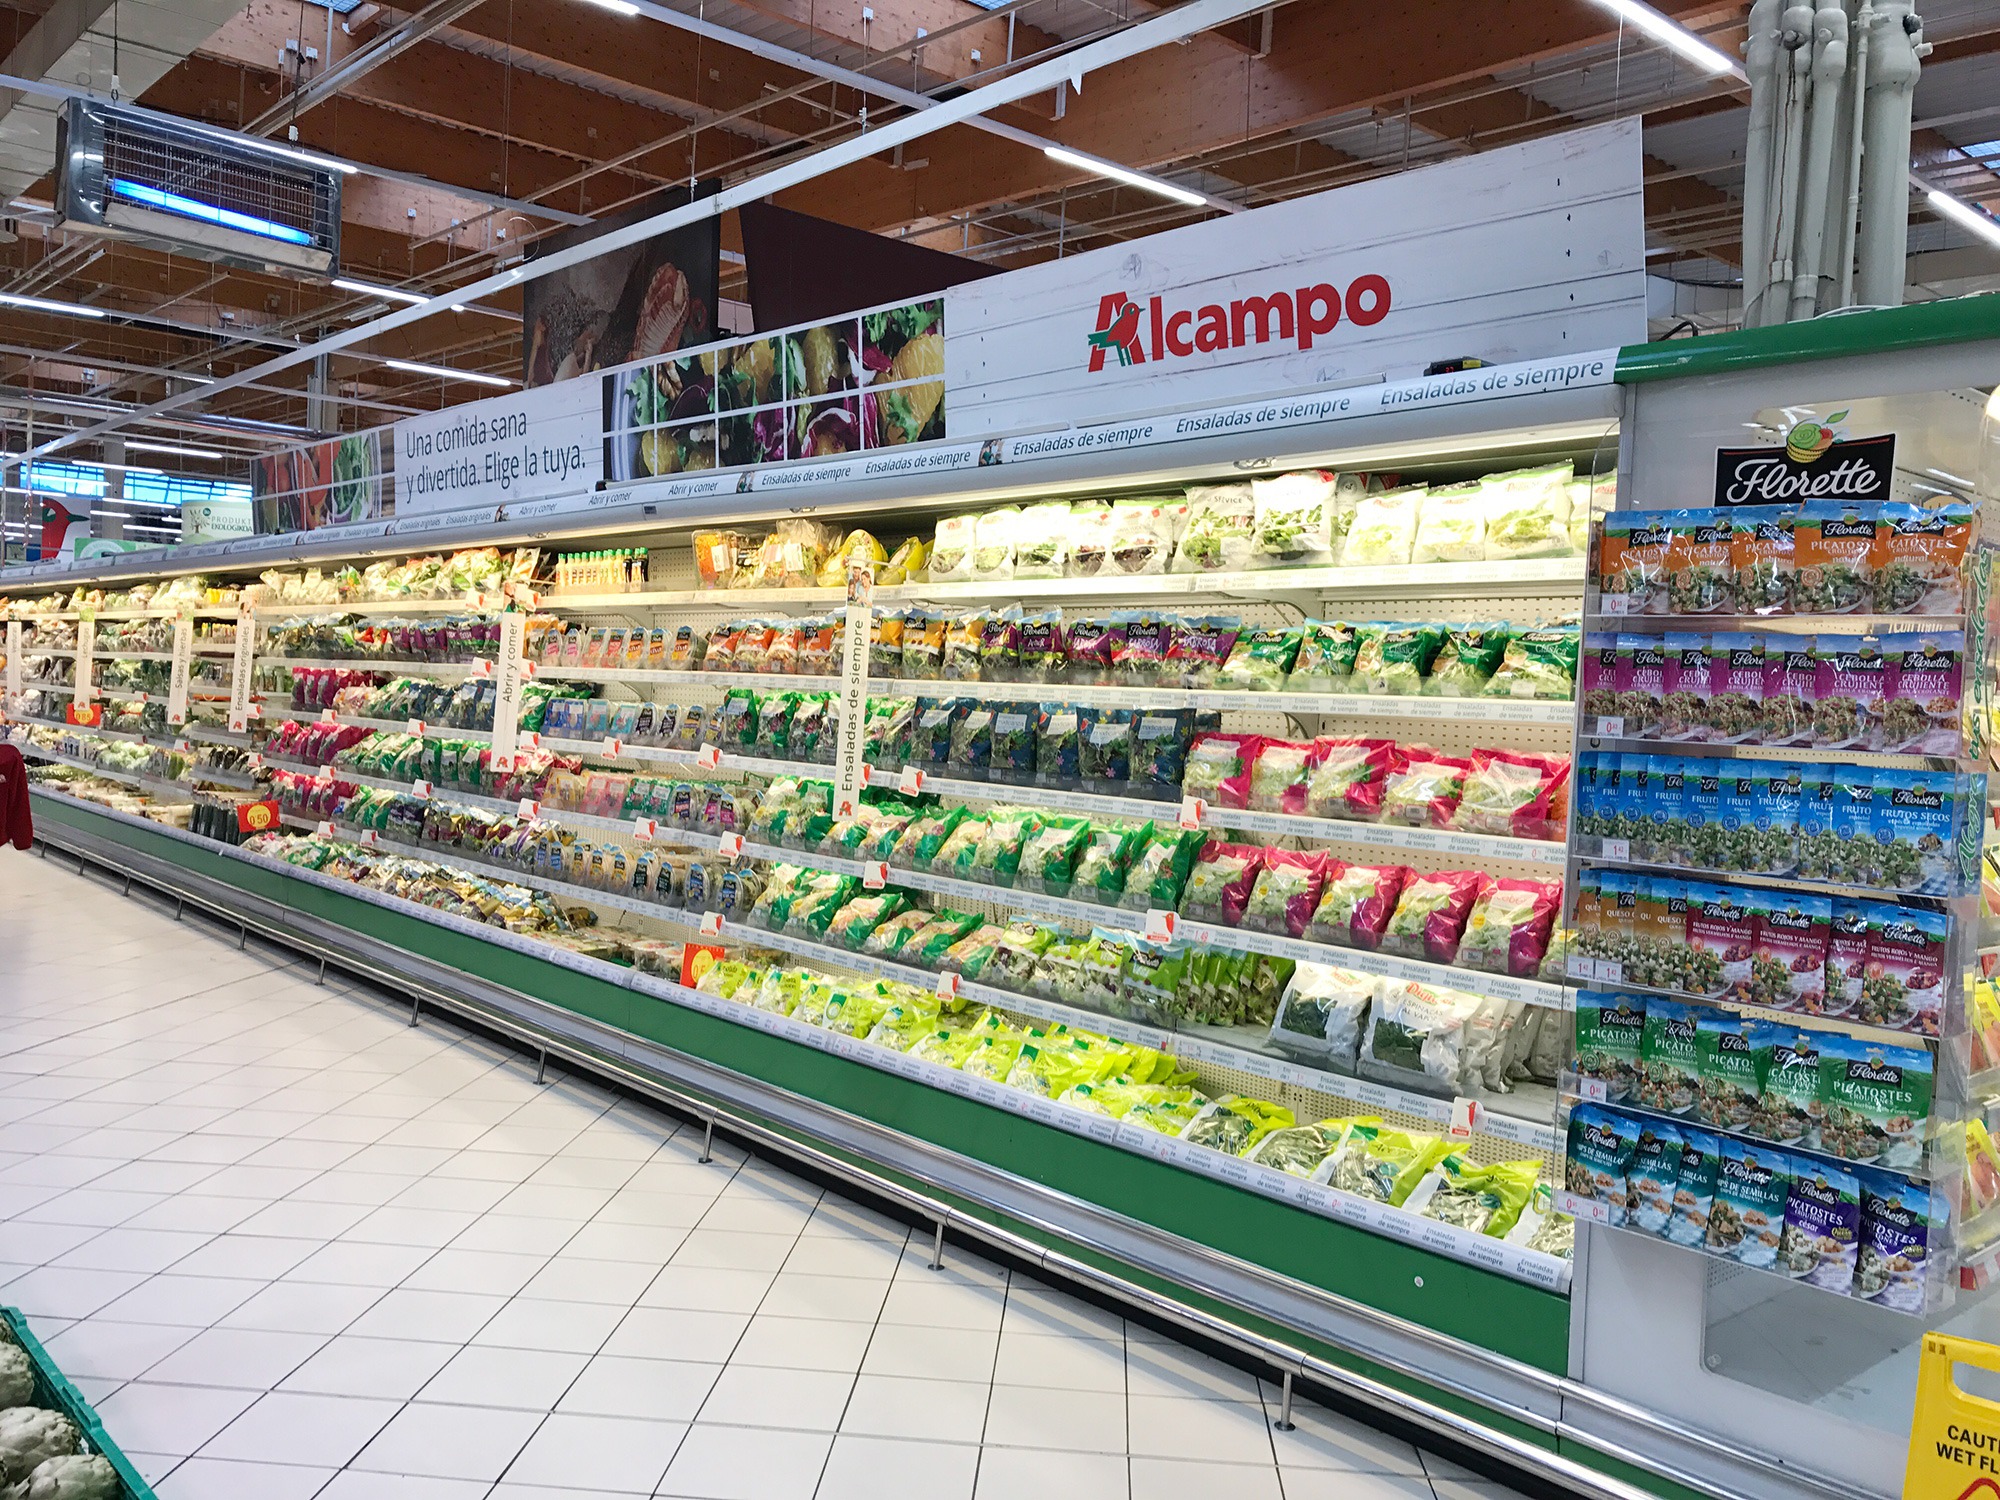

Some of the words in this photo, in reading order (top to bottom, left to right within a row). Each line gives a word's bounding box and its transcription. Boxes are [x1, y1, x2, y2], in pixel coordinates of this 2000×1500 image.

[1088, 274, 1391, 373] Alcampo
[1381, 381, 1477, 406] Ensaladas
[1482, 372, 1508, 392] de
[1513, 361, 1603, 386] siempre
[1176, 411, 1252, 434] Ensaladas
[1256, 406, 1276, 423] de
[1280, 397, 1351, 418] siempre
[406, 431, 432, 459] Una
[435, 414, 487, 453] comida
[491, 412, 527, 442] sana
[1013, 436, 1074, 456] Ensaladas
[1077, 432, 1094, 447] de
[1096, 425, 1153, 447] siempre
[865, 456, 913, 475] Ensaladas
[914, 456, 928, 468] de
[929, 450, 971, 468] siempre
[406, 473, 414, 504] y
[417, 457, 481, 494] divertida.
[485, 453, 519, 489] Elige
[524, 445, 537, 477] la
[543, 444, 586, 481] tuya.
[762, 470, 802, 486] Ensaladas
[803, 469, 814, 482] de
[815, 466, 851, 482] siempre
[1725, 457, 1882, 503] Florette
[668, 481, 687, 496] Abrir
[686, 484, 694, 496] y
[693, 479, 718, 494] comer
[588, 494, 604, 507] Abrir
[610, 491, 633, 503] comer
[519, 505, 533, 516] Abrir
[538, 503, 557, 514] comer
[1824, 522, 1874, 537] Florette
[1970, 546, 1988, 704] ensaladas
[508, 623, 518, 660] comer
[849, 619, 864, 685] siempre
[1904, 653, 1951, 668] Florette
[507, 662, 517, 671] y
[1901, 673, 1946, 683] CEBOLLA
[236, 669, 246, 711] Ensaladas
[502, 674, 514, 702] Abrir
[846, 689, 860, 709] de
[842, 712, 857, 791] Ensaladas
[1894, 792, 1940, 807] Florette
[1881, 808, 1918, 820] FRUTOS
[1921, 811, 1951, 823] SECOS
[1606, 909, 1632, 918] QUESO
[1657, 916, 1682, 925] QUESO
[1703, 903, 1742, 921] Florette
[1771, 911, 1810, 928] Florette
[1884, 925, 1926, 946] Florette
[1914, 952, 1938, 962] MANGO
[1451, 978, 1475, 990] siempre
[1497, 986, 1521, 999] siempre
[1602, 1011, 1643, 1027] Florette
[1850, 1063, 1899, 1084] Florette
[1833, 1080, 1913, 1103] PICATOSTES
[1487, 1117, 1518, 1132] Ensaladas
[1493, 1127, 1519, 1140] siempre
[1584, 1127, 1618, 1150] Florette
[1595, 1150, 1625, 1165] SEMILLAS
[1724, 1161, 1772, 1186] Florette
[1728, 1181, 1739, 1191] DE
[1741, 1185, 1780, 1203] SEMILLAS
[1800, 1180, 1836, 1205] Florette
[1786, 1195, 1844, 1226] PICATOSTES
[1868, 1198, 1911, 1227] Florette
[1426, 1226, 1456, 1242] Ensaladas
[1799, 1219, 1819, 1234] césar
[1431, 1236, 1456, 1251] siempre
[1472, 1241, 1504, 1258] Ensaladas
[1478, 1252, 1504, 1267] siempre
[1520, 1257, 1554, 1275] Ensaladas
[1527, 1268, 1554, 1284] siempre
[1936, 1441, 1976, 1467] WET
